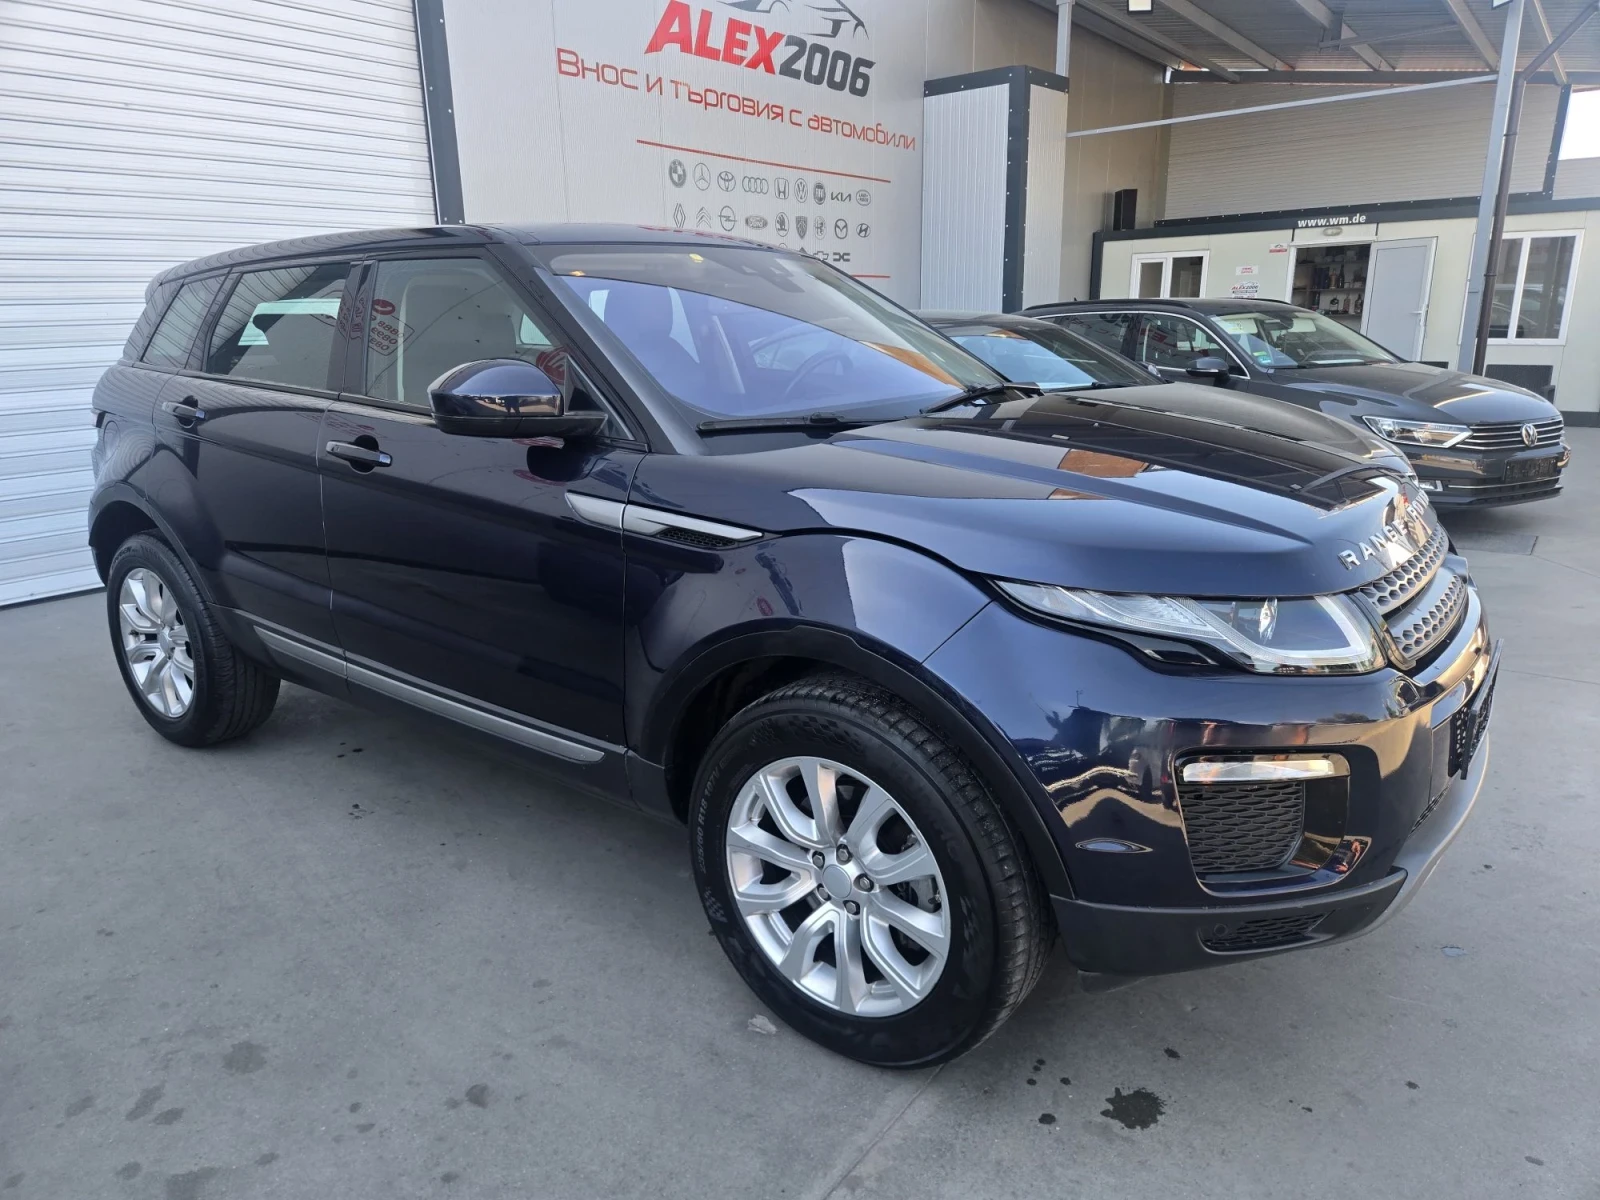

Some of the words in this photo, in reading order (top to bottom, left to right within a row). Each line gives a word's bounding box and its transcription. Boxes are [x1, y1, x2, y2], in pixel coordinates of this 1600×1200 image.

[644, 0, 876, 98] ALEX2006
[556, 47, 639, 91] Внос
[669, 78, 784, 124] търговия
[807, 113, 916, 152] автомобили
[1297, 213, 1367, 228] www.wm.de
[1337, 519, 1408, 570] RANGE
